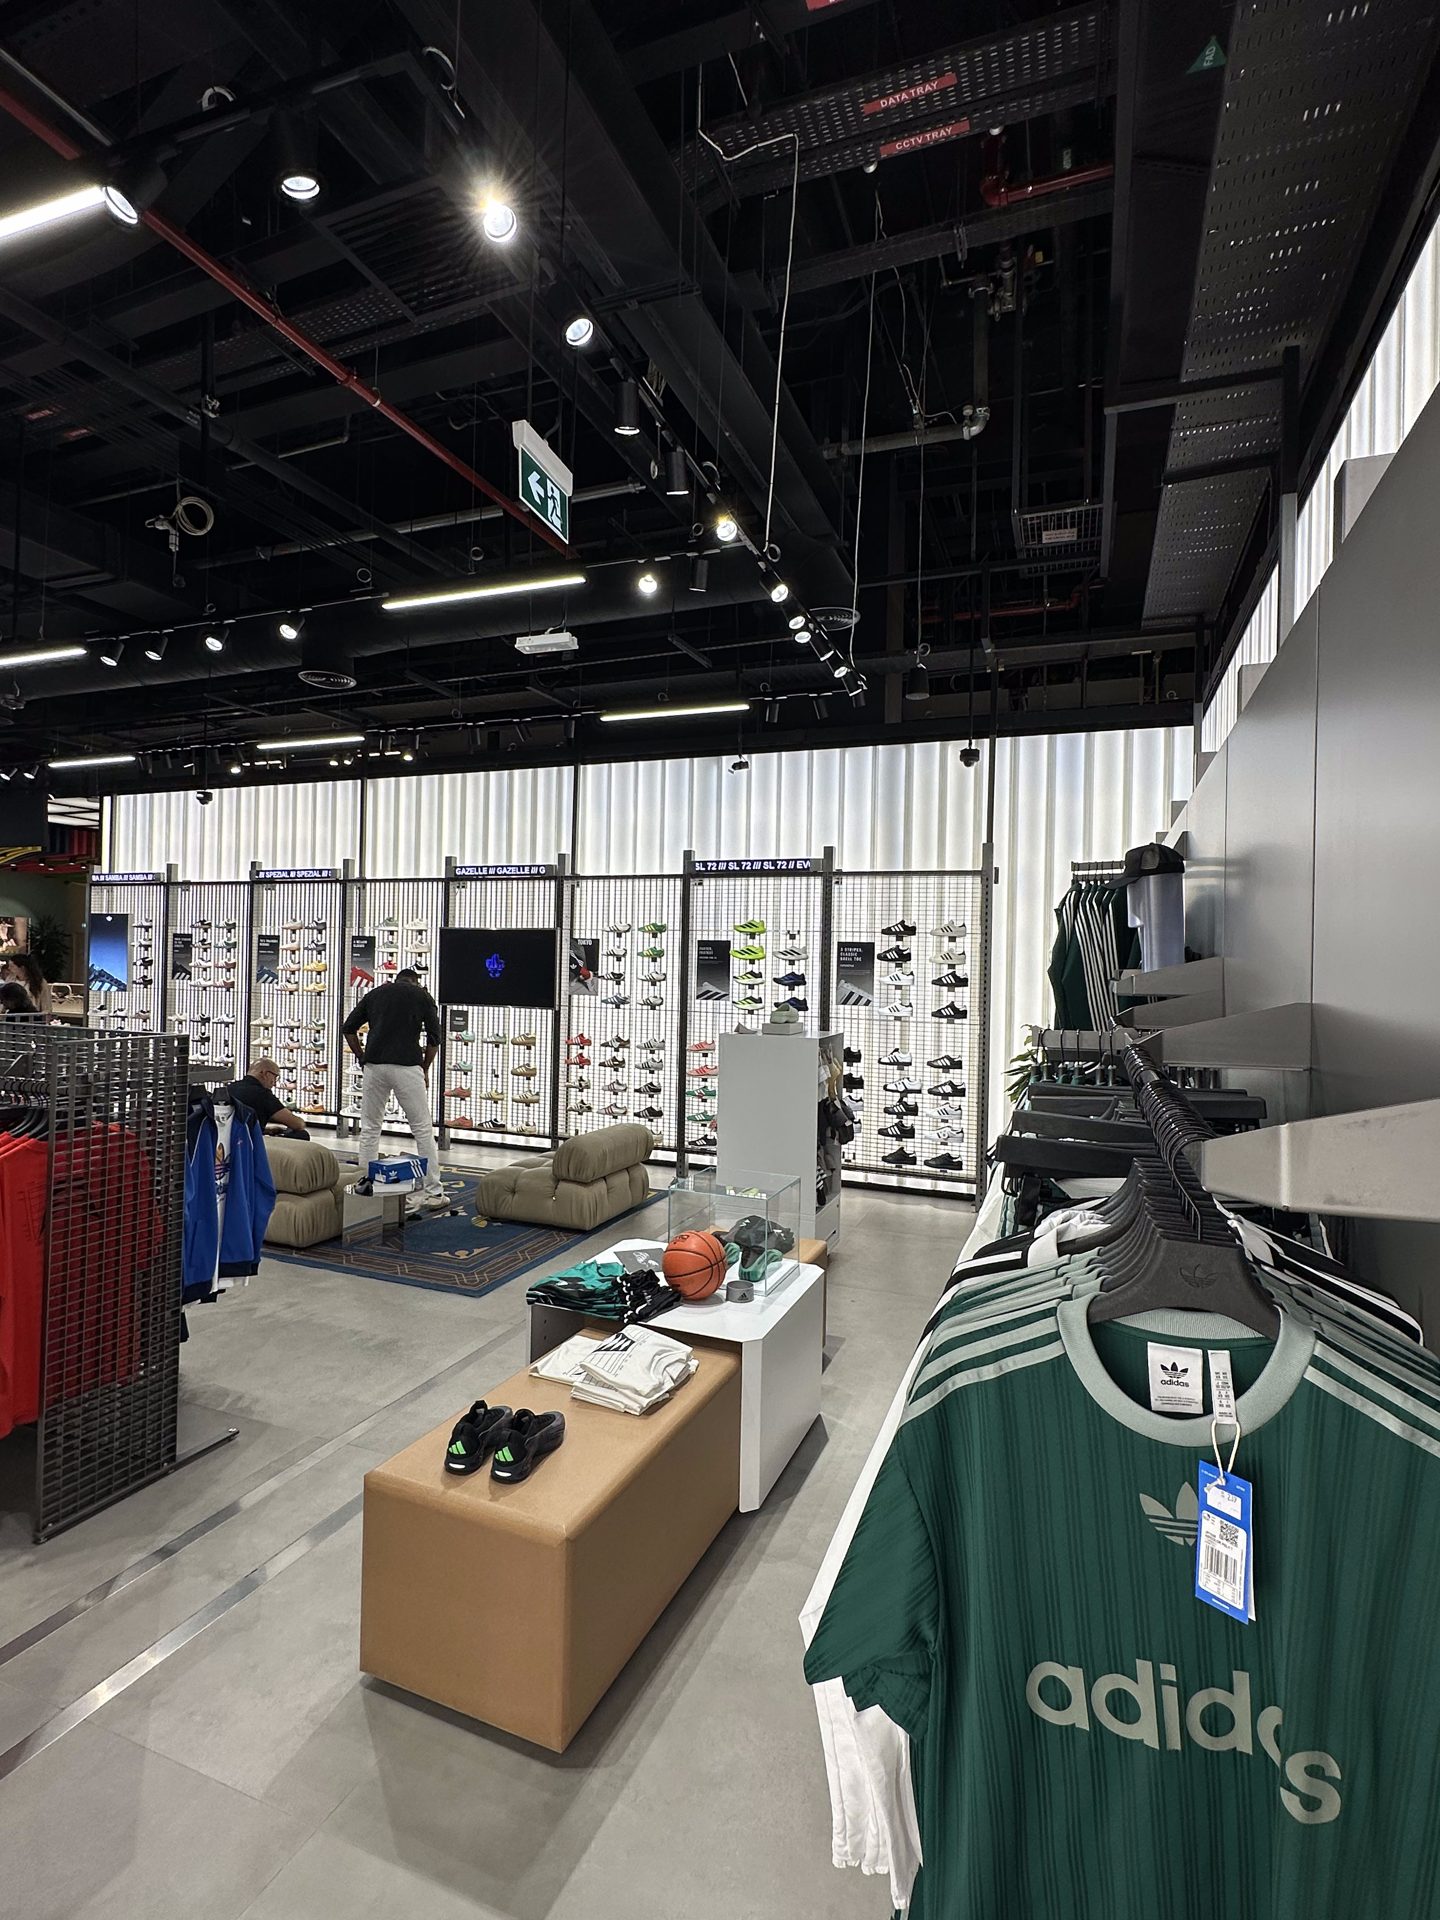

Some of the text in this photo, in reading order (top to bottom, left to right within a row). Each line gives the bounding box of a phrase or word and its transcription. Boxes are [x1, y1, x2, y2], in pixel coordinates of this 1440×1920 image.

[880, 80, 939, 109] DATA TRAY
[895, 127, 953, 151] CCTV TRAY
[707, 862, 717, 871] 72
[728, 861, 740, 870] SL
[741, 861, 752, 870] 72
[762, 861, 776, 870] SL
[776, 860, 787, 870] 72
[265, 871, 290, 879] SPEZIAL
[296, 870, 321, 878] SPEZIAL
[455, 867, 488, 876] GAZELLE
[496, 866, 530, 875] GAZELLE
[1160, 1378, 1190, 1388] adidas
